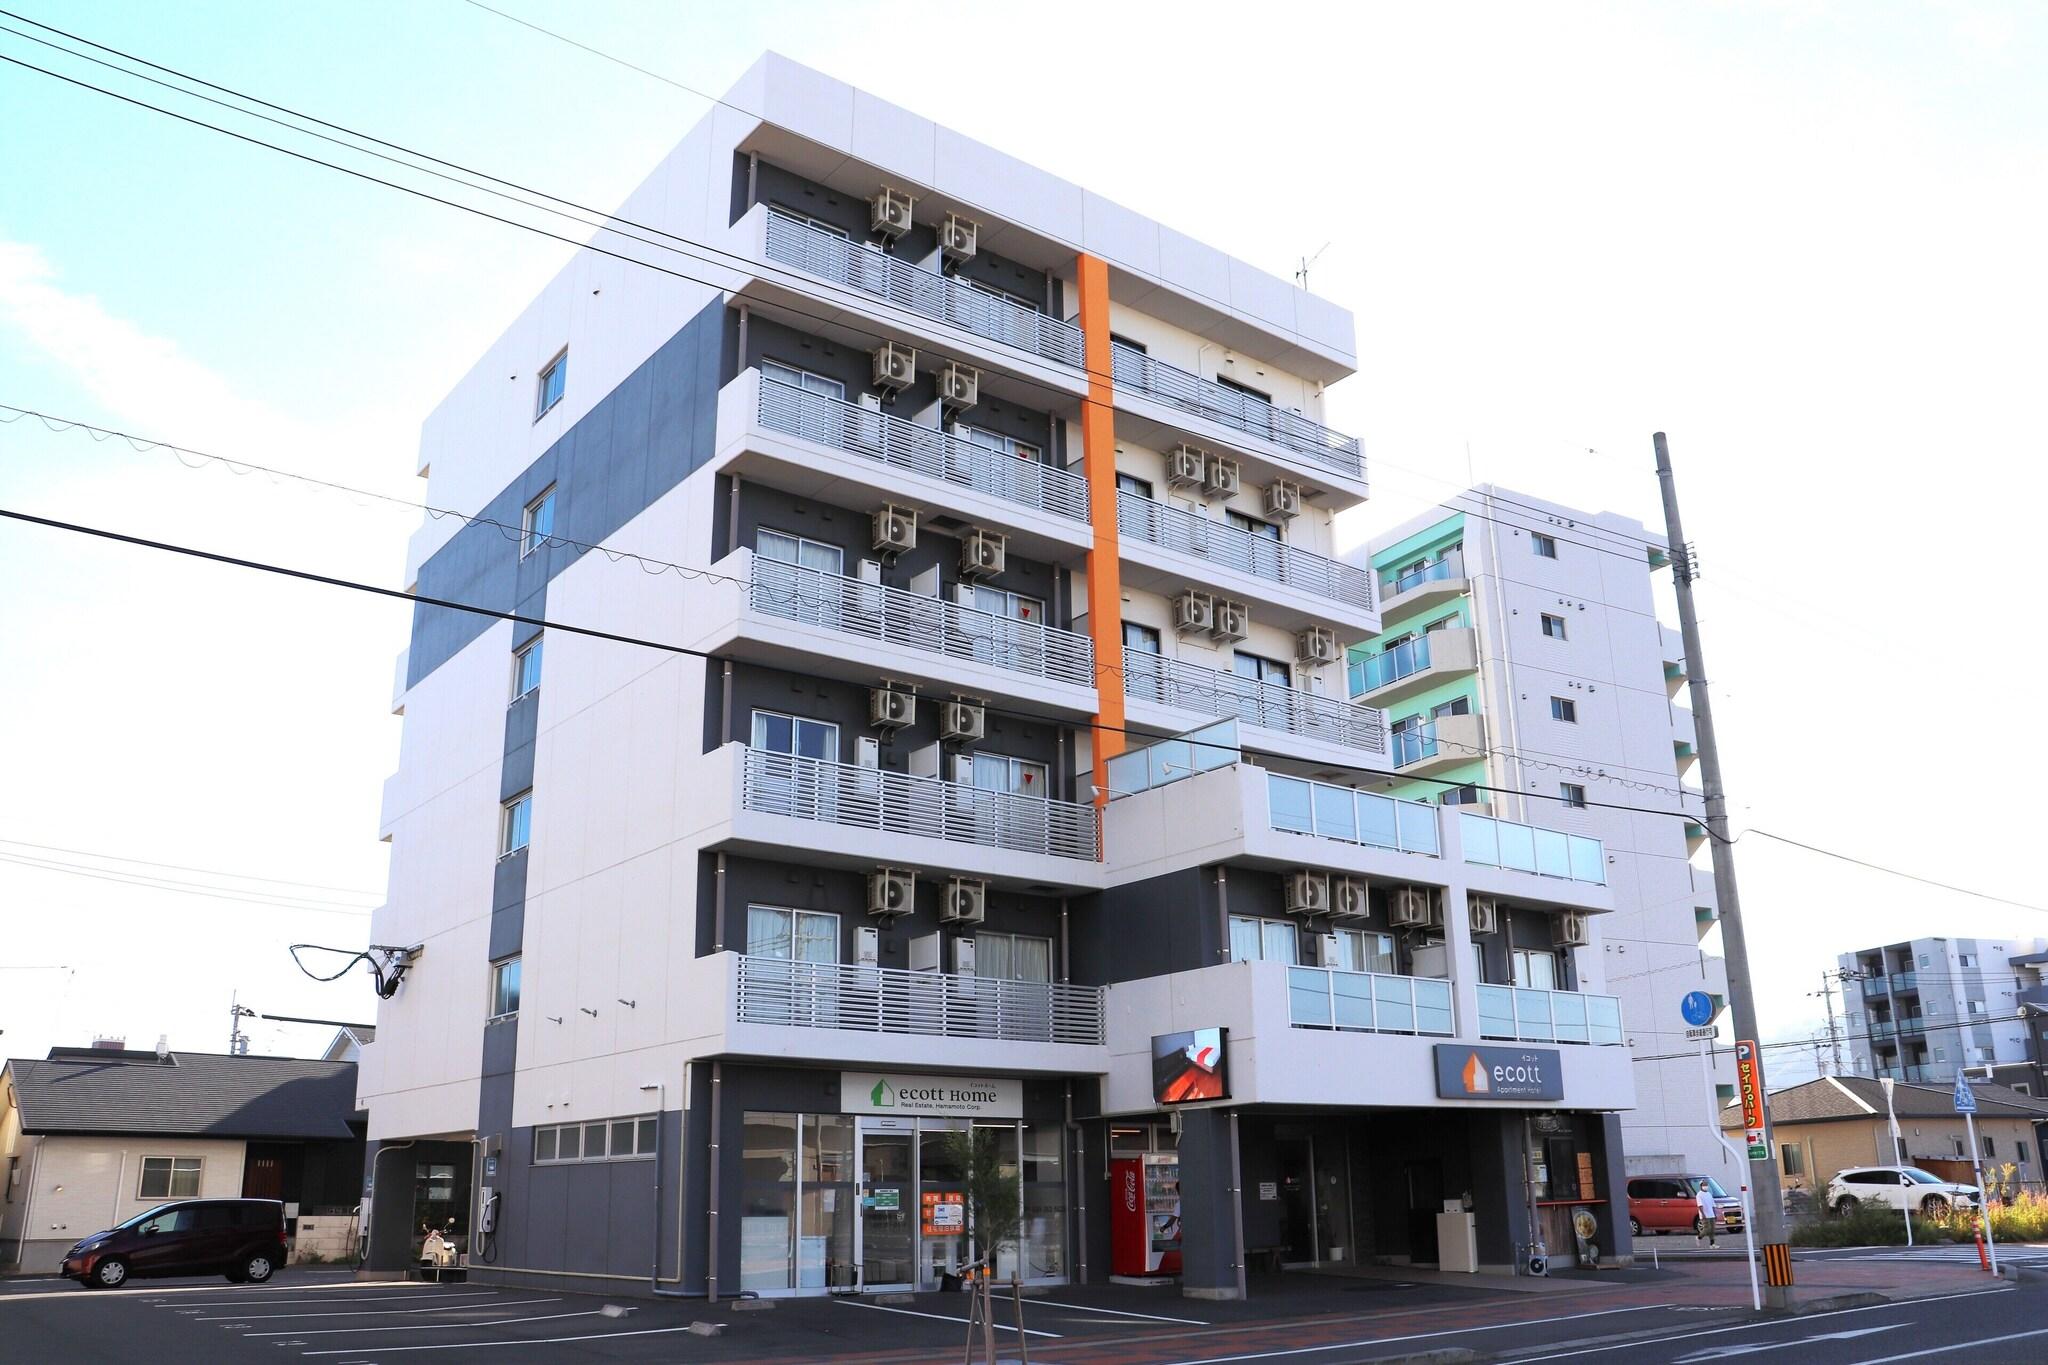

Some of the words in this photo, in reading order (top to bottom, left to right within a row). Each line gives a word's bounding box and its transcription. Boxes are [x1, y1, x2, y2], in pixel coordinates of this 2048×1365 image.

[1738, 1045, 1750, 1060] P
[1493, 1065, 1542, 1083] ecott
[900, 1088, 944, 1101] ecott
[950, 1089, 997, 1103] Home
[1740, 1063, 1756, 1127] セイワパーク
[1126, 1169, 1137, 1212] Coca-Cola
